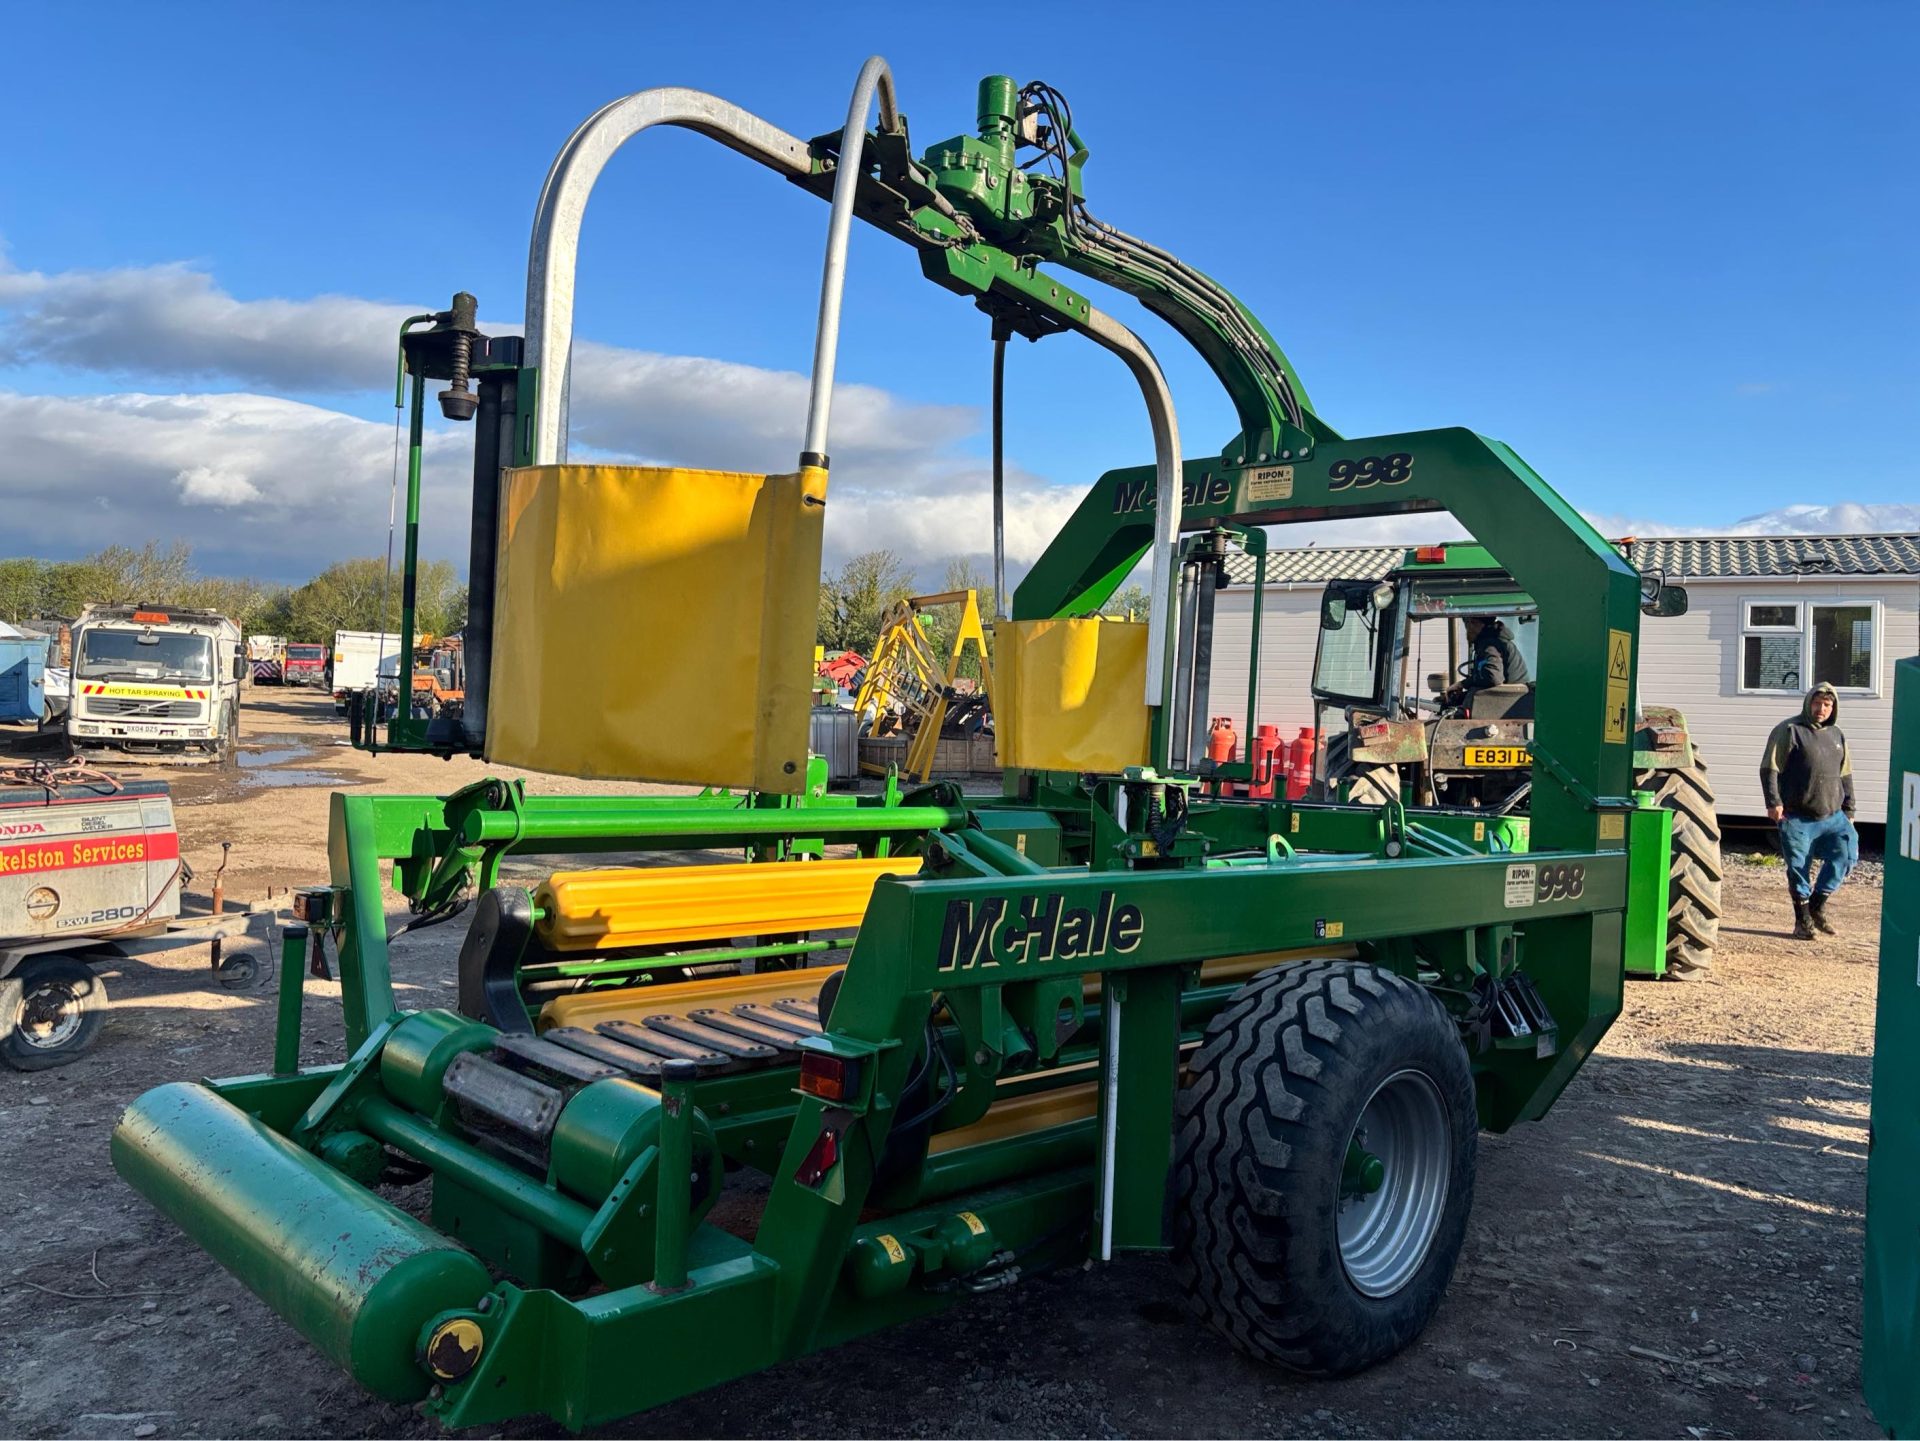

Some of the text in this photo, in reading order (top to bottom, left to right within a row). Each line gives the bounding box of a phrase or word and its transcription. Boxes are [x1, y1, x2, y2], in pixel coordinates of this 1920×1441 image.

[1257, 470, 1284, 480] RIPON
[1328, 453, 1414, 491] 998
[143, 690, 181, 698] SPRAYING
[1475, 750, 1511, 763] E831
[73, 840, 144, 864] Services
[1511, 868, 1530, 879] RIPON
[1538, 863, 1585, 903] 998
[56, 917, 89, 928] EXW
[938, 889, 1144, 972] McHale
